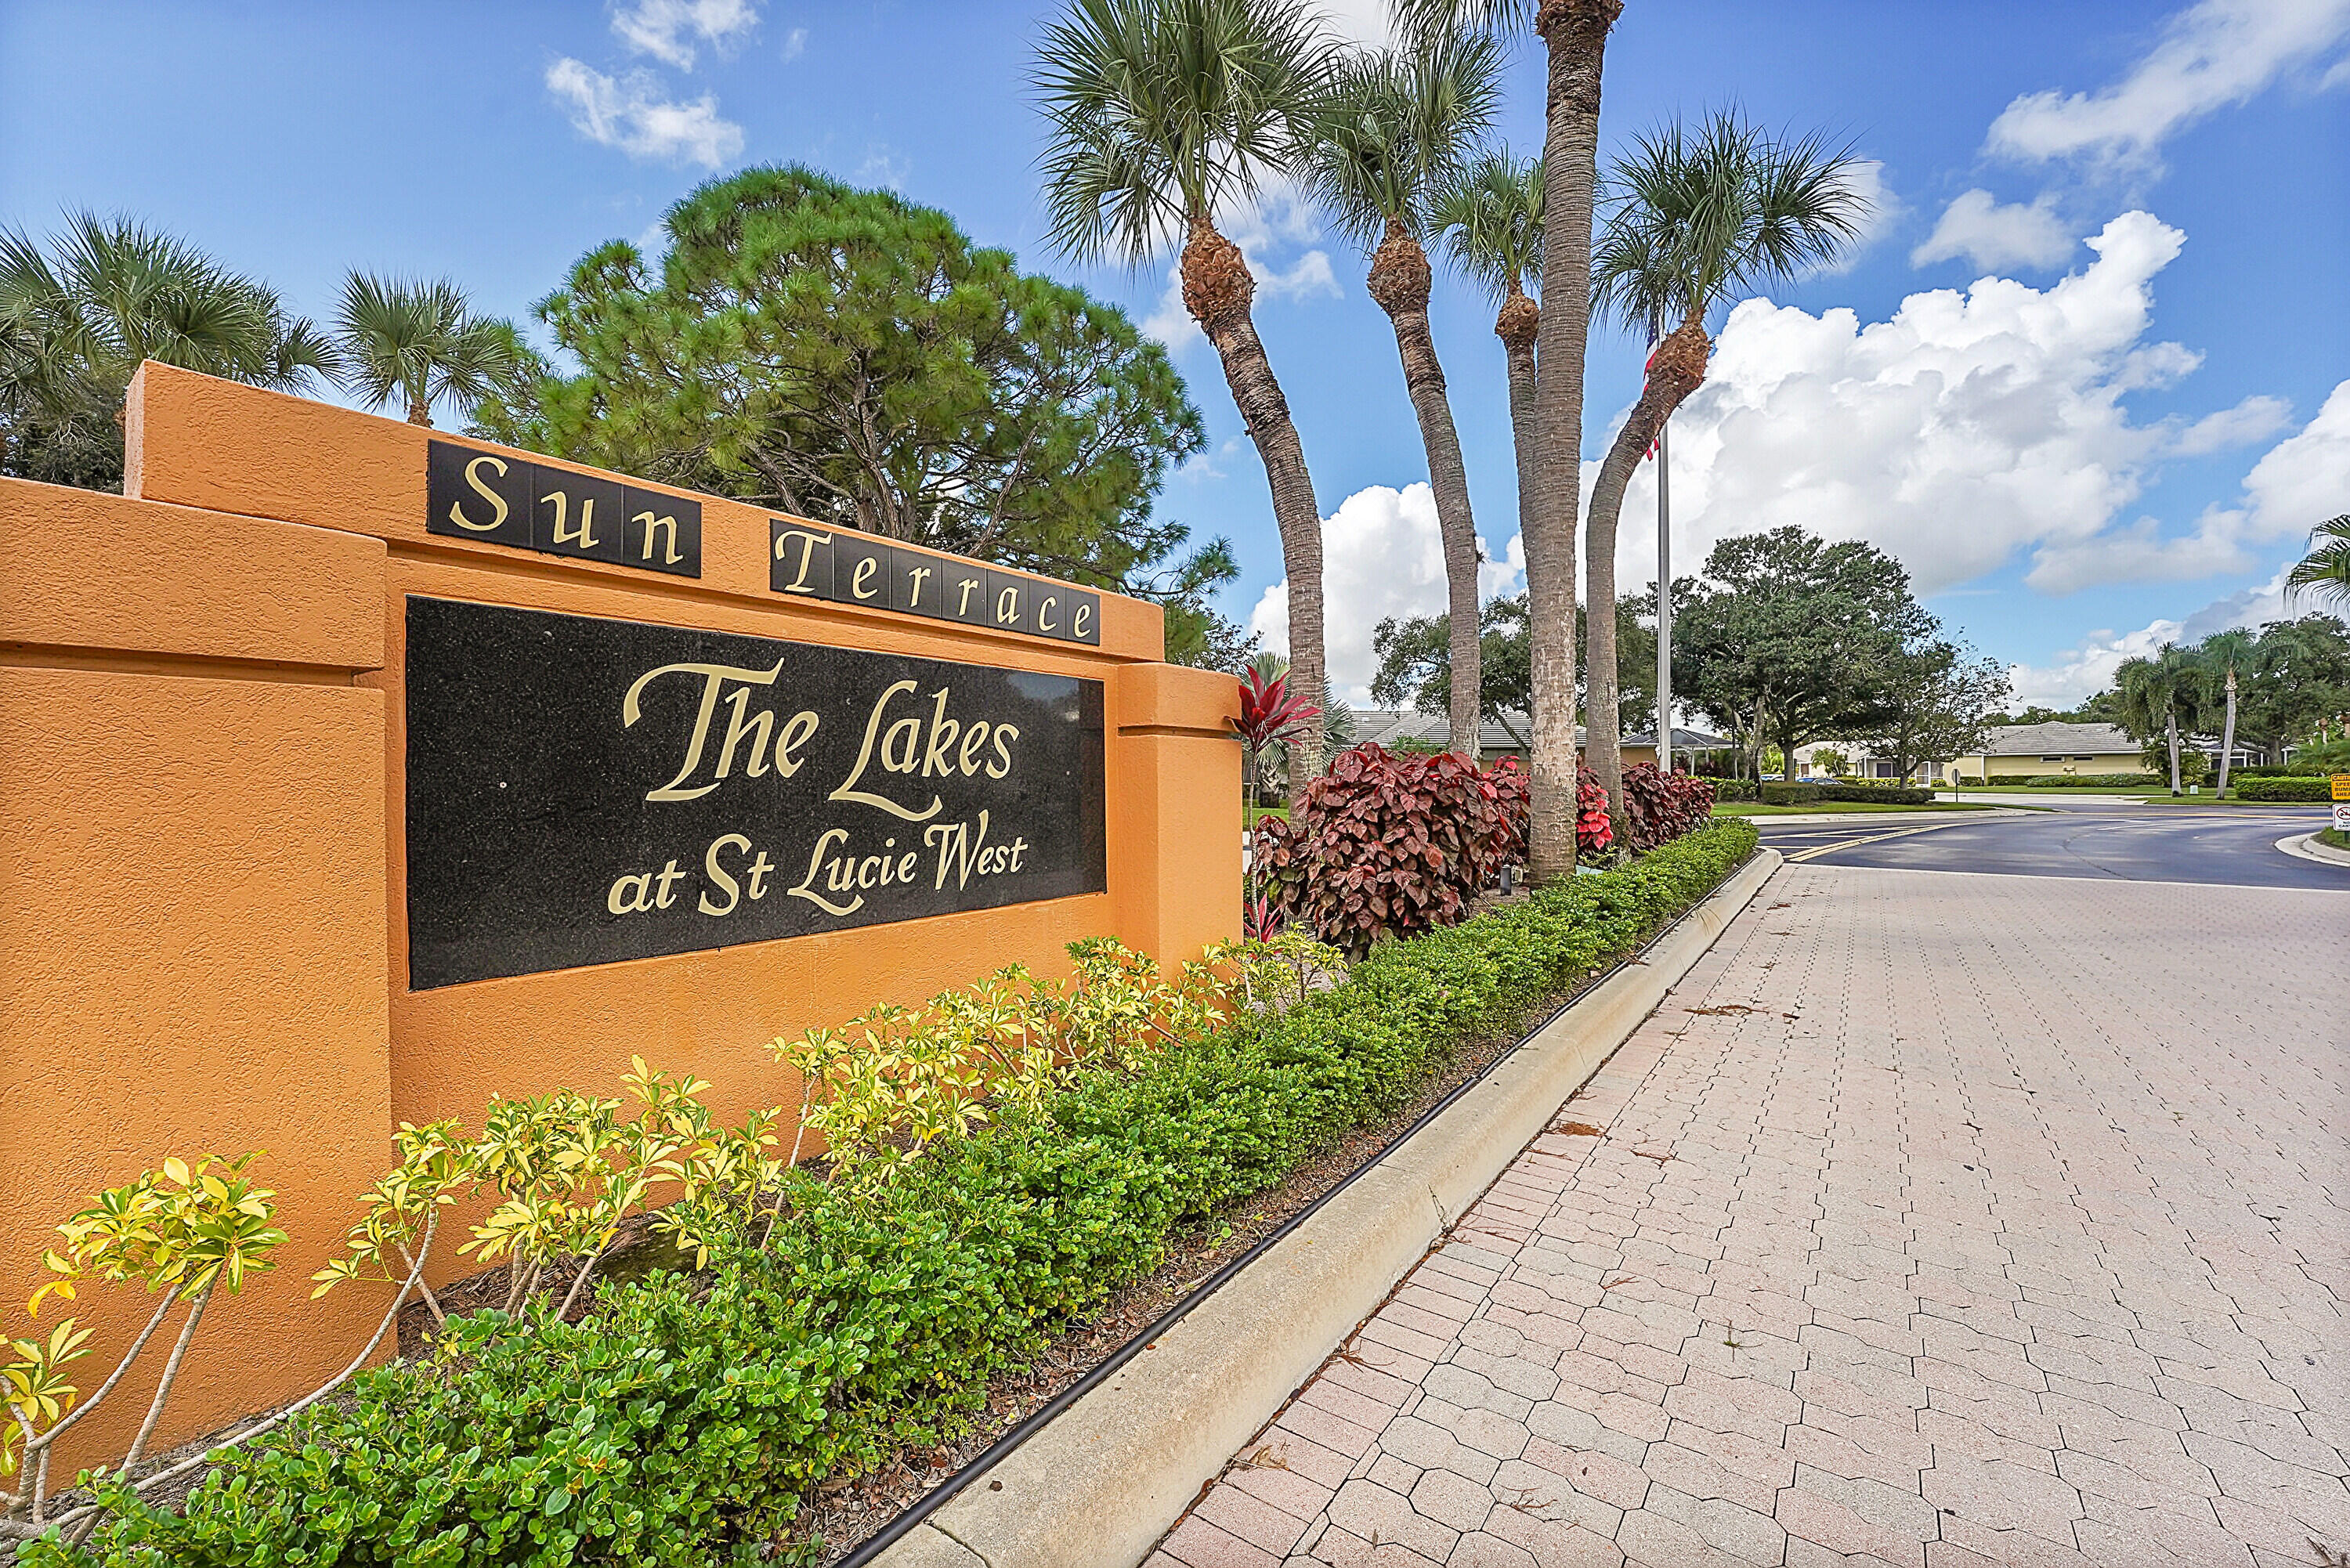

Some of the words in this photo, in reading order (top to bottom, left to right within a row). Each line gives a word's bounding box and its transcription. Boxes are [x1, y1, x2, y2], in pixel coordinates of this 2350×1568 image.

[449, 456, 684, 567] Sun
[774, 529, 1093, 638] Terrace
[623, 658, 819, 803] The
[826, 680, 1021, 822] Lakes
[607, 860, 685, 916] at
[698, 833, 776, 917] St
[786, 828, 918, 917] Lucie
[924, 811, 1029, 893] West
